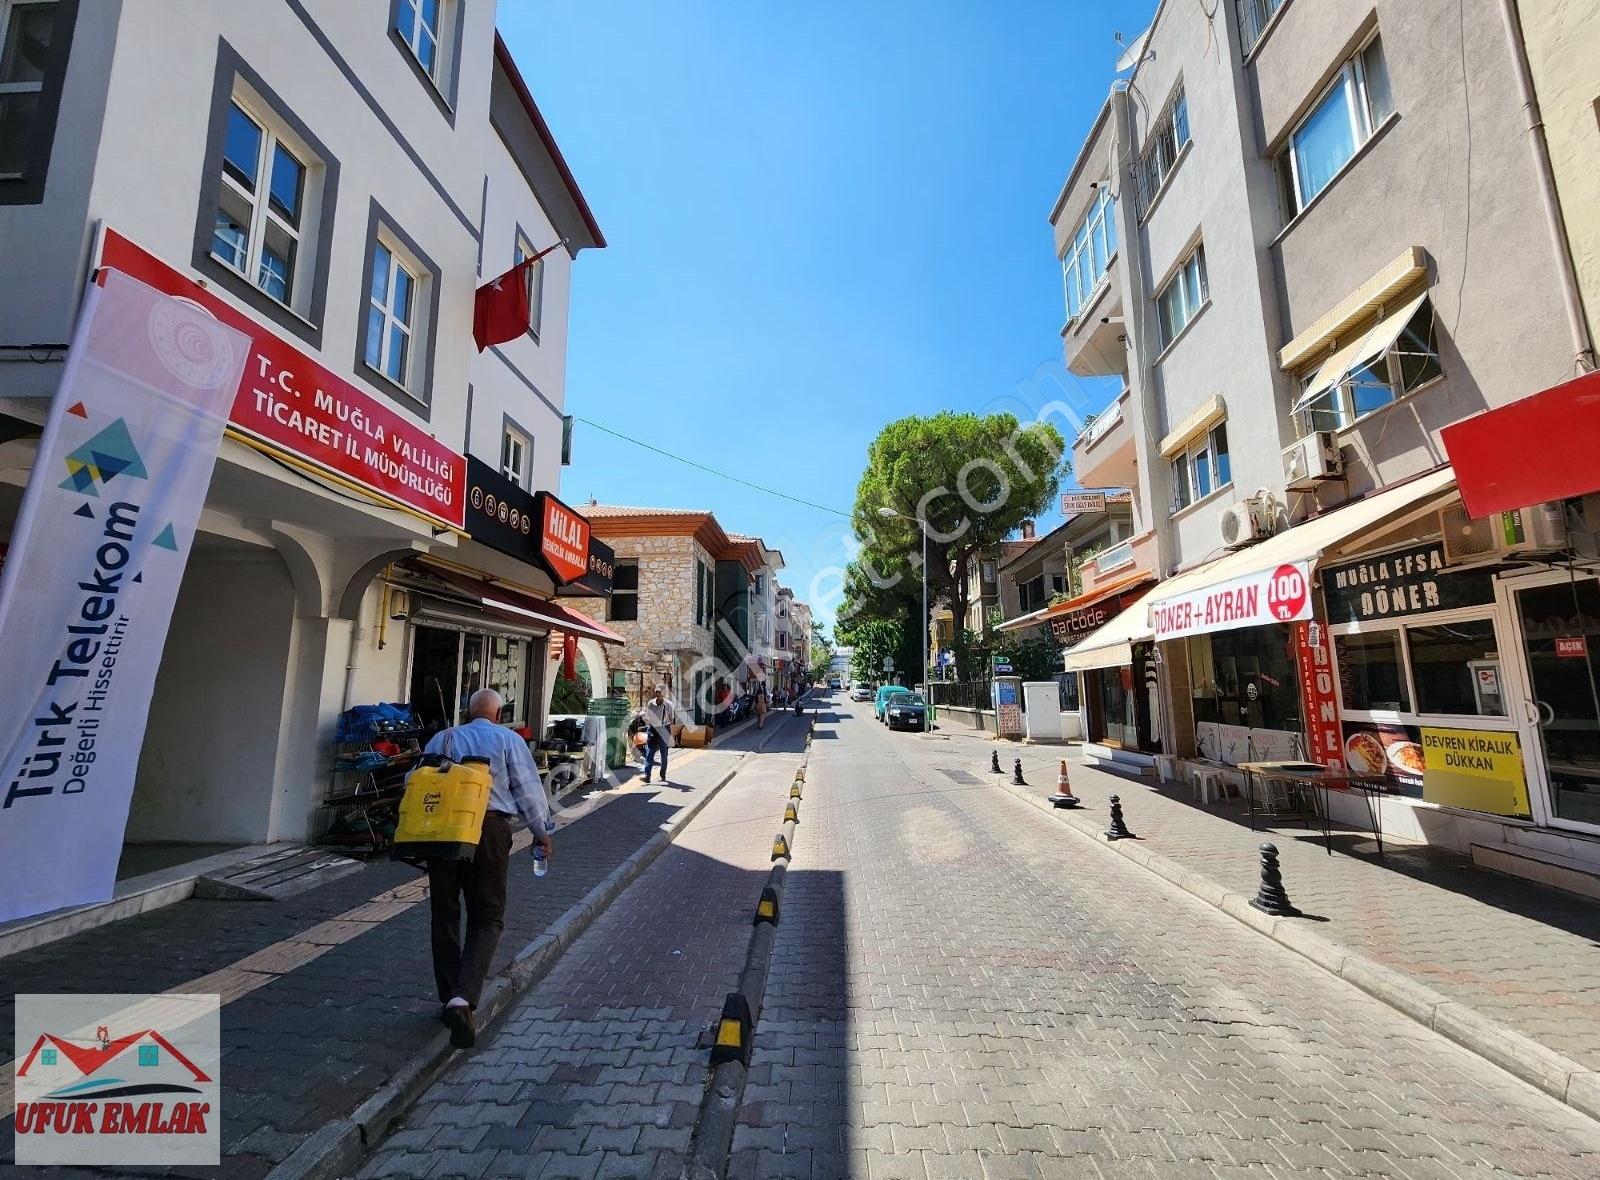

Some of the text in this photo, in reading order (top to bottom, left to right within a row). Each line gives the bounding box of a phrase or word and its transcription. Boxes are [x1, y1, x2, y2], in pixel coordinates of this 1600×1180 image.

[257, 353, 454, 483] T.C. MUĞLA VALİLİĞİ
[252, 388, 452, 506] TİCARET İL MÜDÜRLÜĞÜ
[1270, 573, 1303, 603] 100
[1335, 550, 1442, 589] MUĞLA EFSA
[1154, 602, 1192, 634] DÖNER
[1205, 584, 1259, 625] AYRAN
[1278, 605, 1291, 619] TL
[1361, 581, 1440, 616] DÖNER
[1051, 608, 1104, 636] barcode
[3, 501, 141, 809] Türk Telekom
[1560, 641, 1583, 653] AÇIK
[62, 614, 130, 794] Değerli Hissettirir
[1313, 644, 1342, 775] DÖNER
[1424, 735, 1514, 755] DEVREN KİRALIK
[1445, 752, 1494, 771] DÜKKAN
